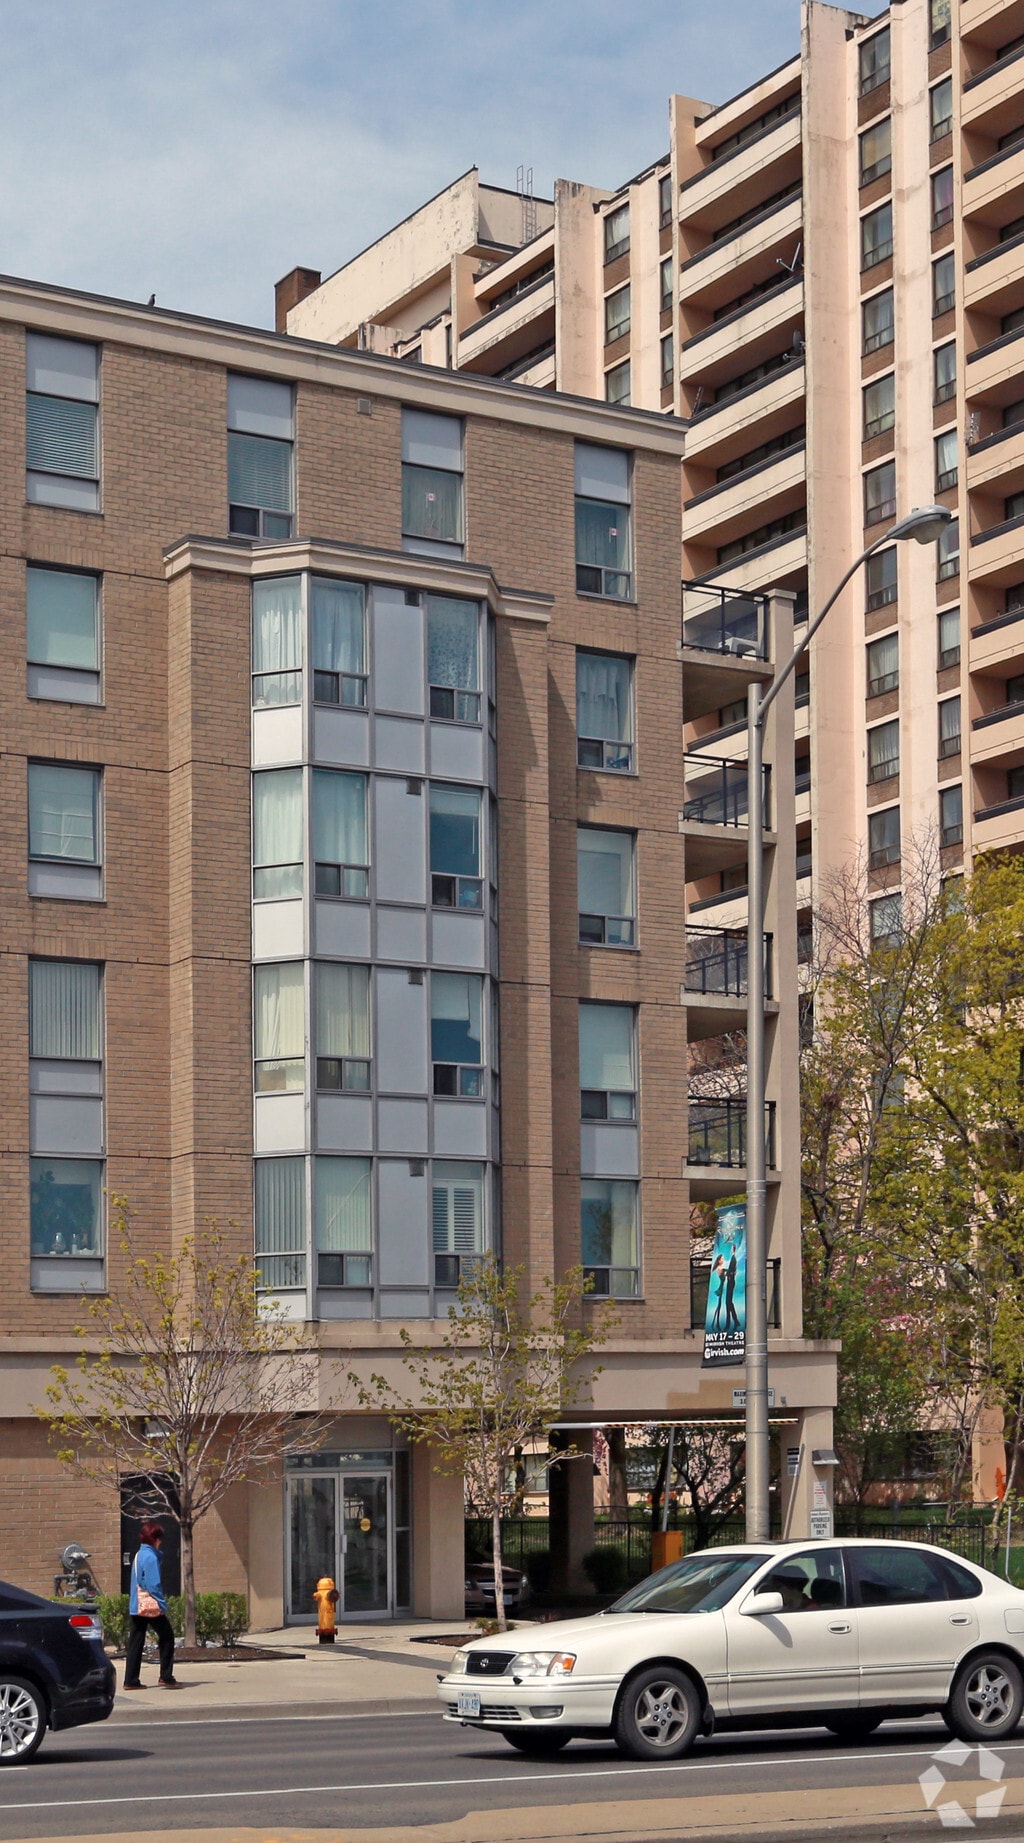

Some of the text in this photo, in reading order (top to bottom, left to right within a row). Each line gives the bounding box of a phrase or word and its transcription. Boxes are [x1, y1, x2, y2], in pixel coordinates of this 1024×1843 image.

[705, 1333, 718, 1342] MAY
[719, 1332, 727, 1341] 17
[734, 1331, 744, 1340] 29
